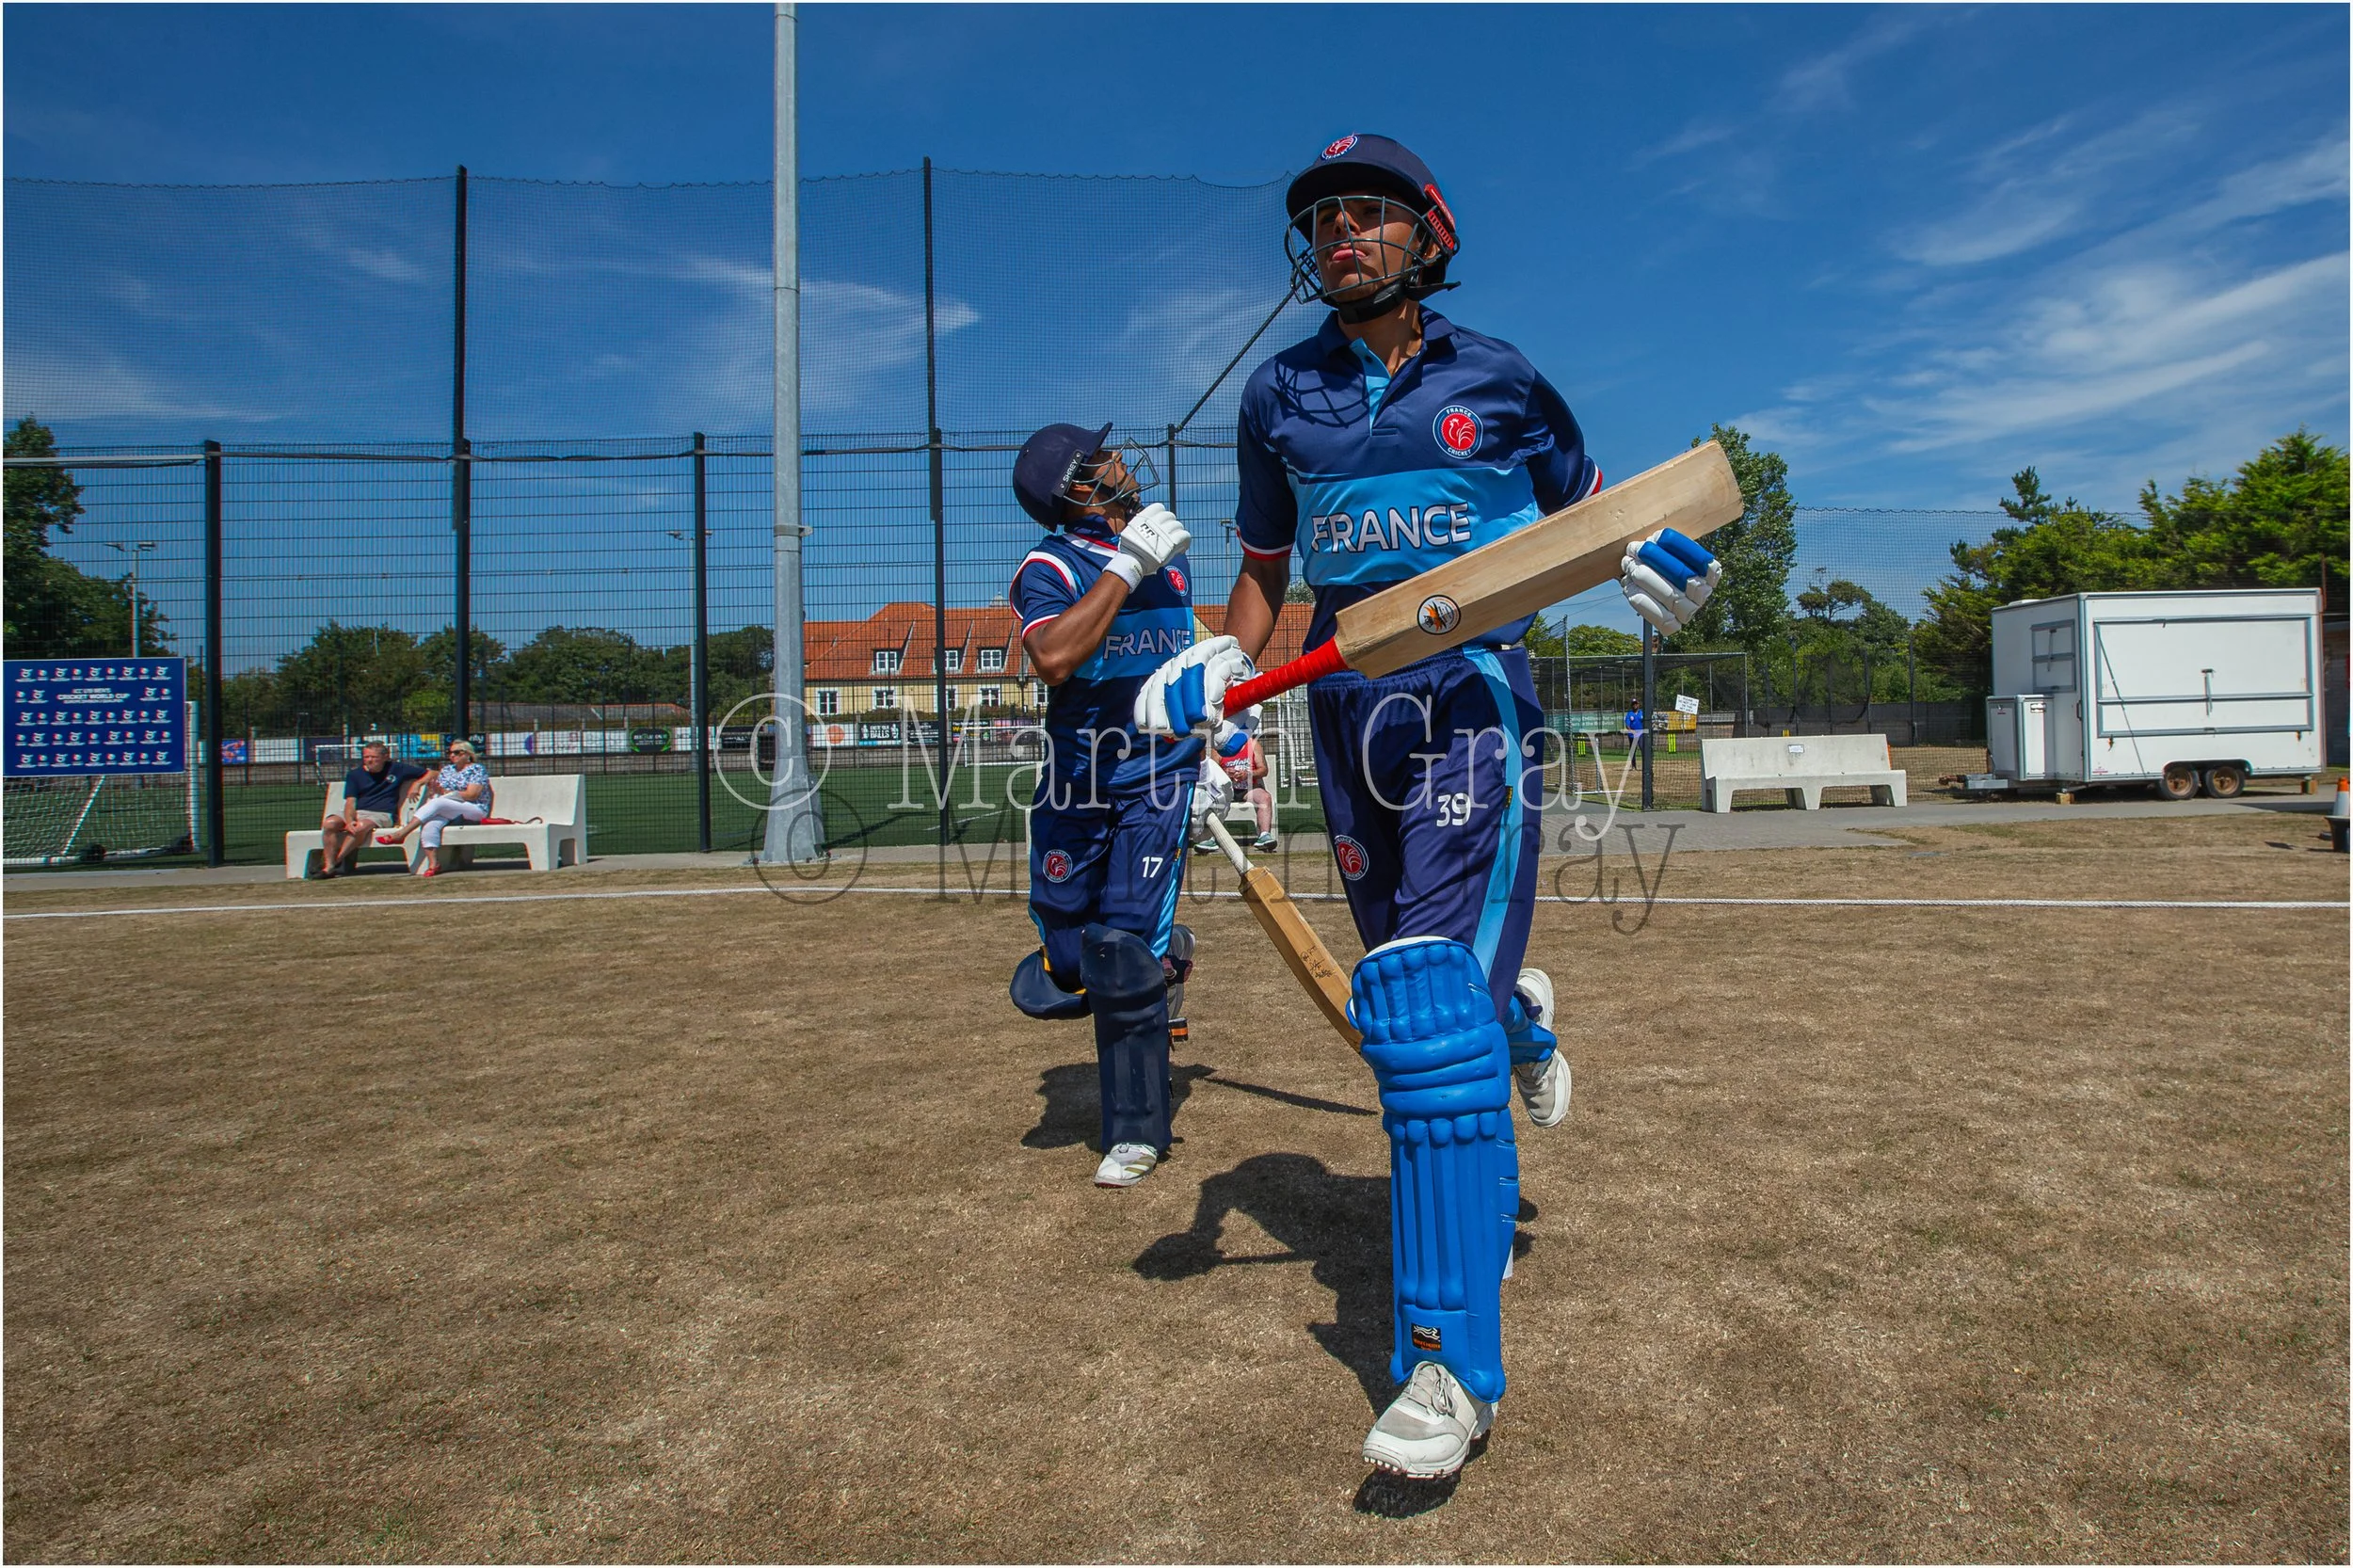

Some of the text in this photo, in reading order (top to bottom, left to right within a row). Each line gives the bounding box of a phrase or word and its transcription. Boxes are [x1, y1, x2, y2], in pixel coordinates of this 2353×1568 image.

[1446, 407, 1472, 418] FRANCE
[1447, 447, 1471, 456] CRICKET
[1063, 458, 1078, 482] SHREY
[1311, 503, 1472, 554] FRANCE
[870, 730, 890, 739] BALLS
[1436, 792, 1471, 827] 39
[1142, 856, 1164, 878] 17
